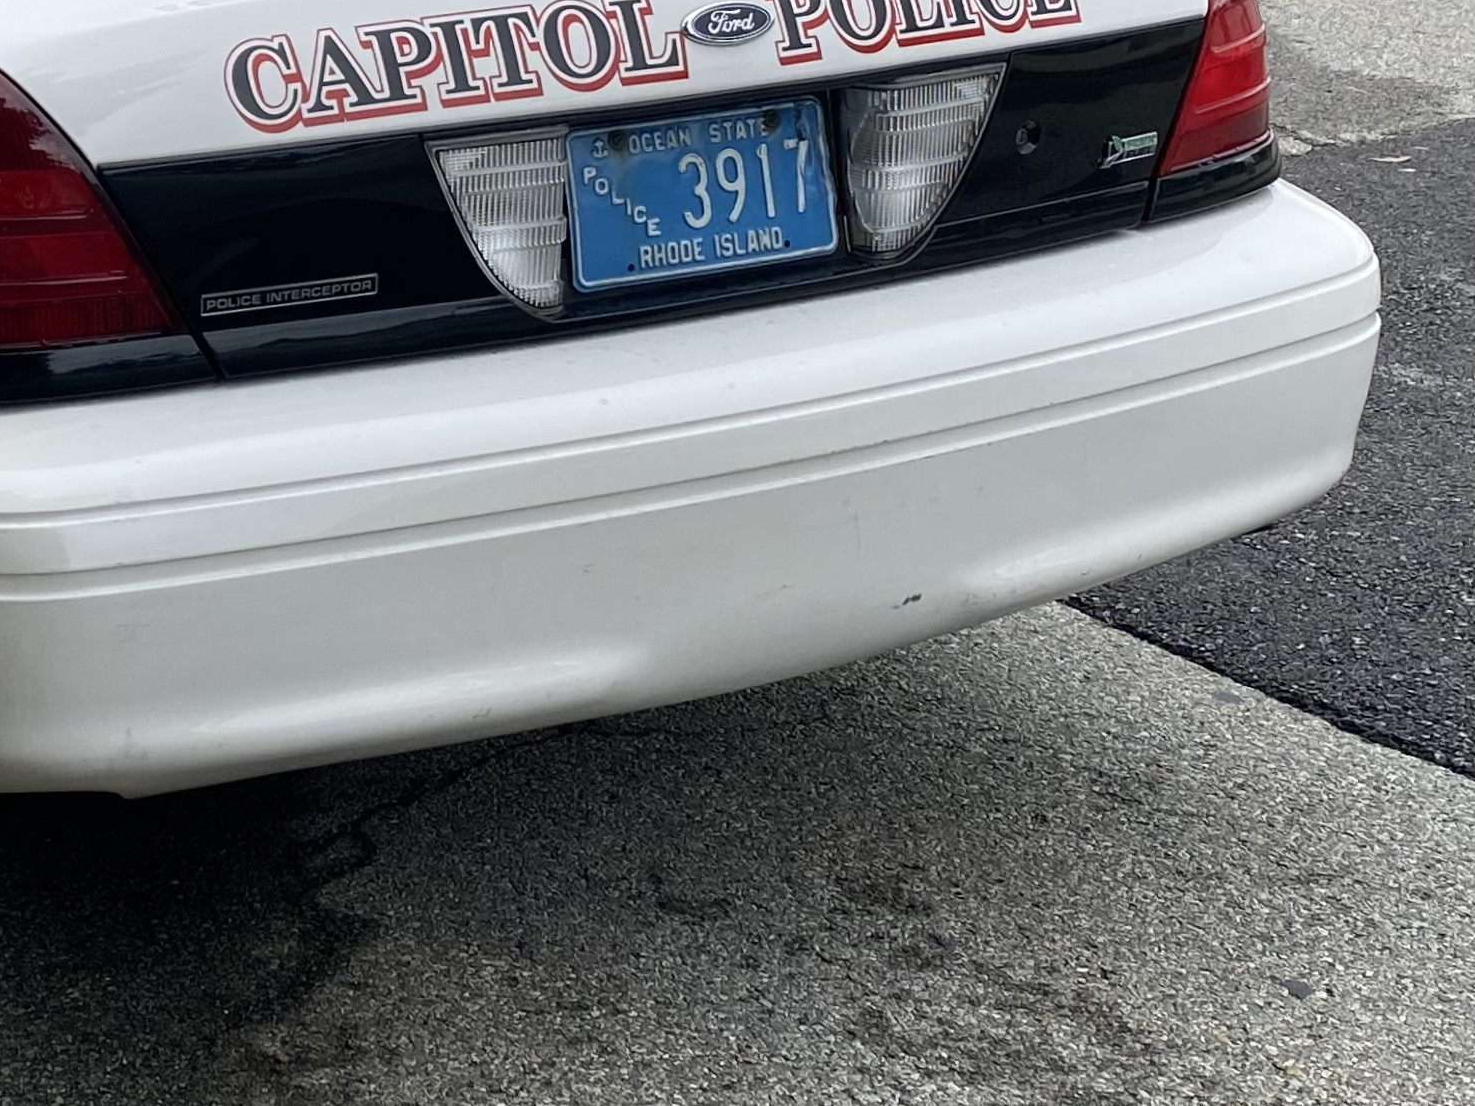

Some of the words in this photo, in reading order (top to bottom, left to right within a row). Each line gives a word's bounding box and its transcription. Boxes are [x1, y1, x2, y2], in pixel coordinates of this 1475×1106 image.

[707, 9, 756, 34] Ford
[628, 127, 692, 155] OCEAN
[582, 166, 662, 237] POLICE
[678, 139, 808, 229] 3917
[639, 237, 706, 269] RHODE
[713, 226, 784, 258] ISLAND
[206, 294, 261, 310] POLICE
[266, 279, 372, 304] INTERCEPTOR
